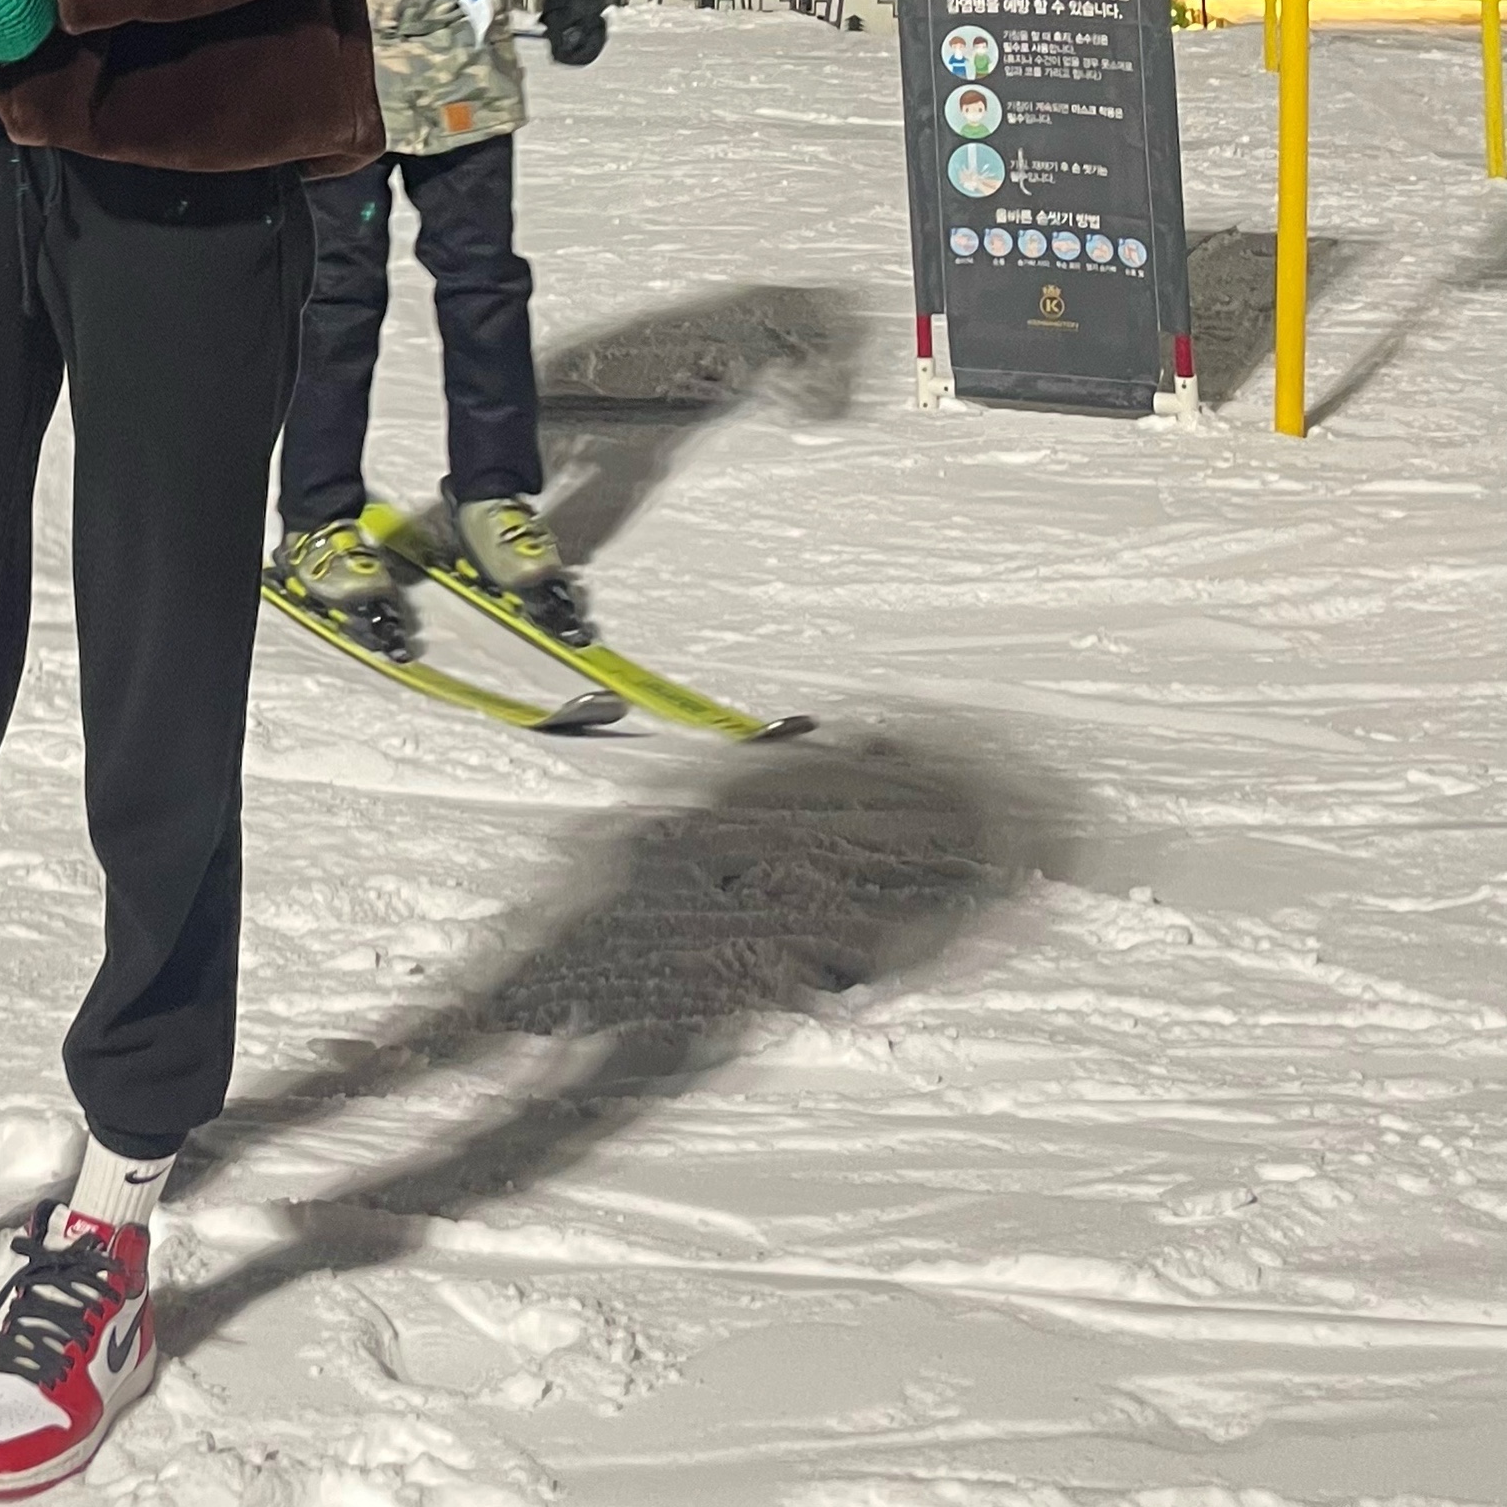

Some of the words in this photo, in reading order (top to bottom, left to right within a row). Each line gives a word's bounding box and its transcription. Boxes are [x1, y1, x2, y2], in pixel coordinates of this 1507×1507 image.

[1003, 0, 1030, 15] 예방
[1051, 0, 1065, 15] 수
[995, 208, 1032, 224] 올바른
[1036, 209, 1073, 226] 손씻기
[1076, 213, 1100, 230] 방법
[1045, 298, 1059, 312] K
